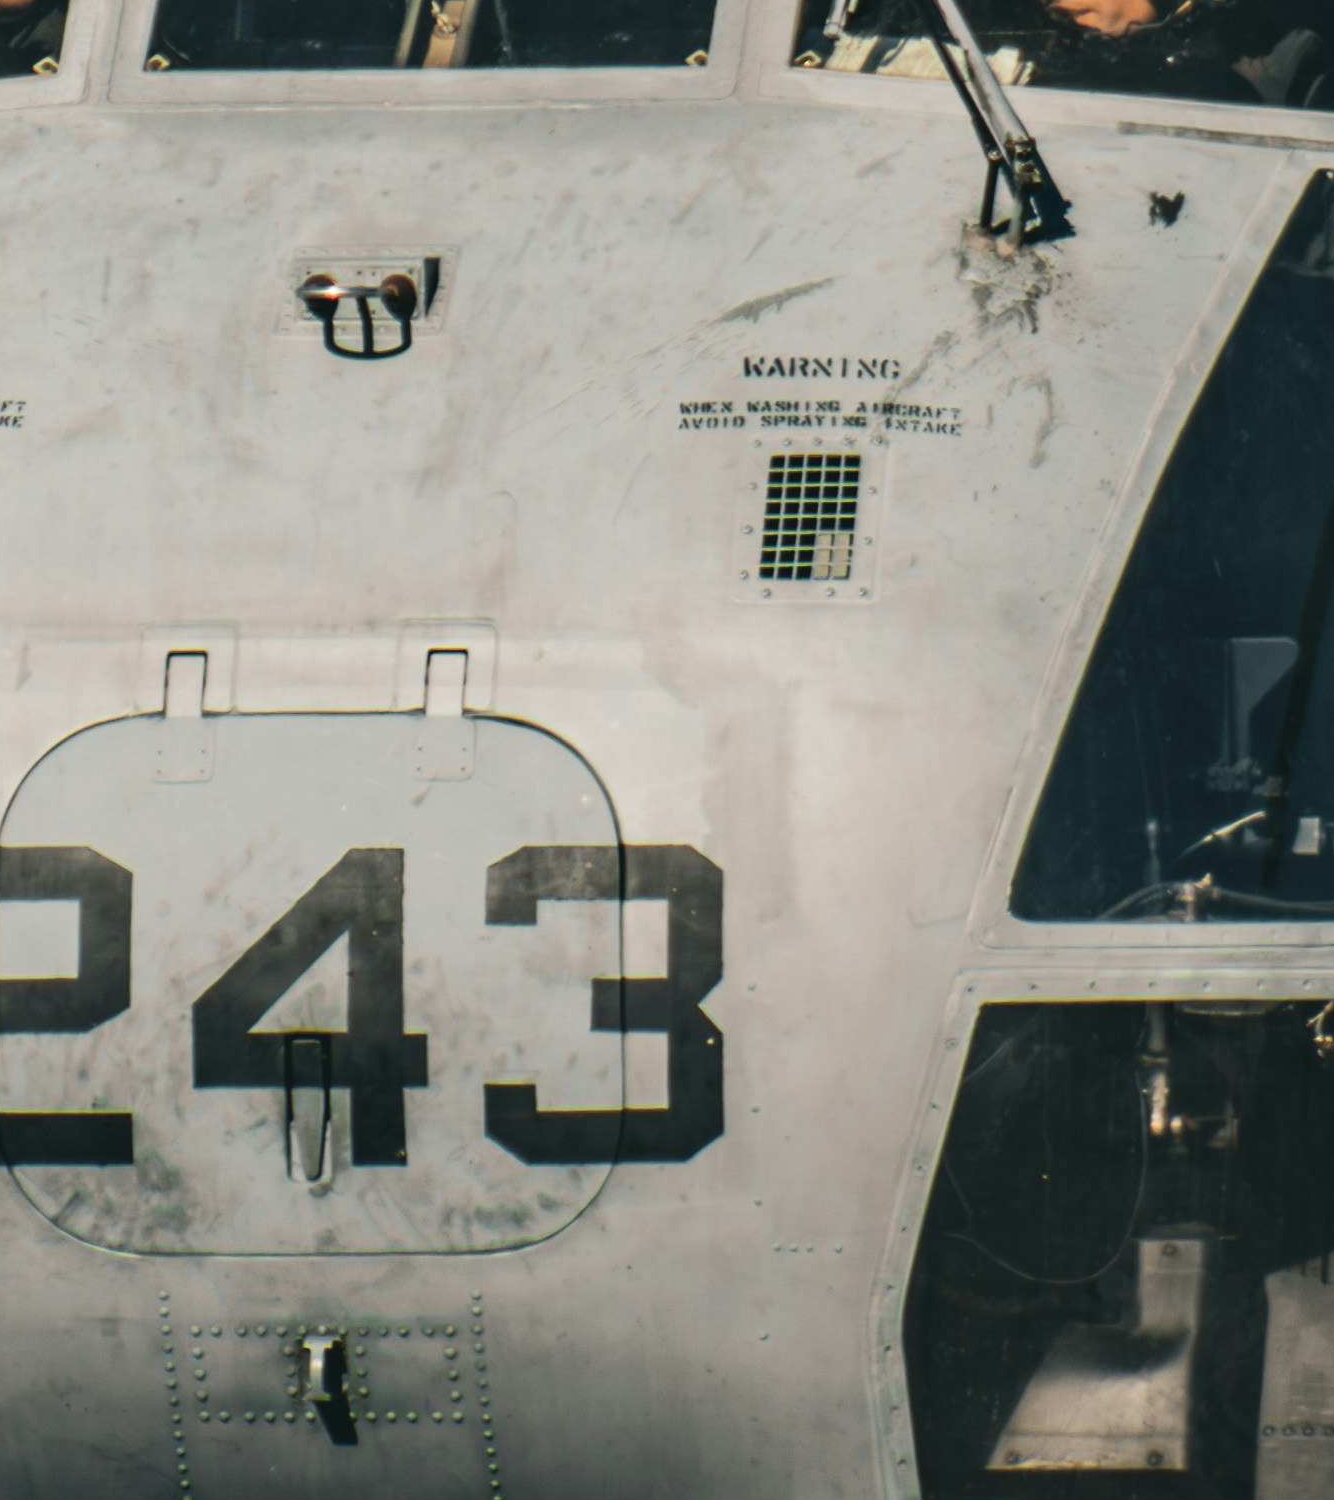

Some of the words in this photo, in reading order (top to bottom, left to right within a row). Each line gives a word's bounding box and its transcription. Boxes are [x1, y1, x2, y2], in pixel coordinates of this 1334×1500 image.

[743, 355, 902, 380] WARNING
[679, 400, 734, 415] WHEN
[747, 399, 842, 414] WASHING
[856, 400, 963, 421] AIRCRAFT
[678, 415, 746, 430] AVOID
[760, 413, 868, 429] SPRAYING
[884, 415, 963, 437] INTAKE
